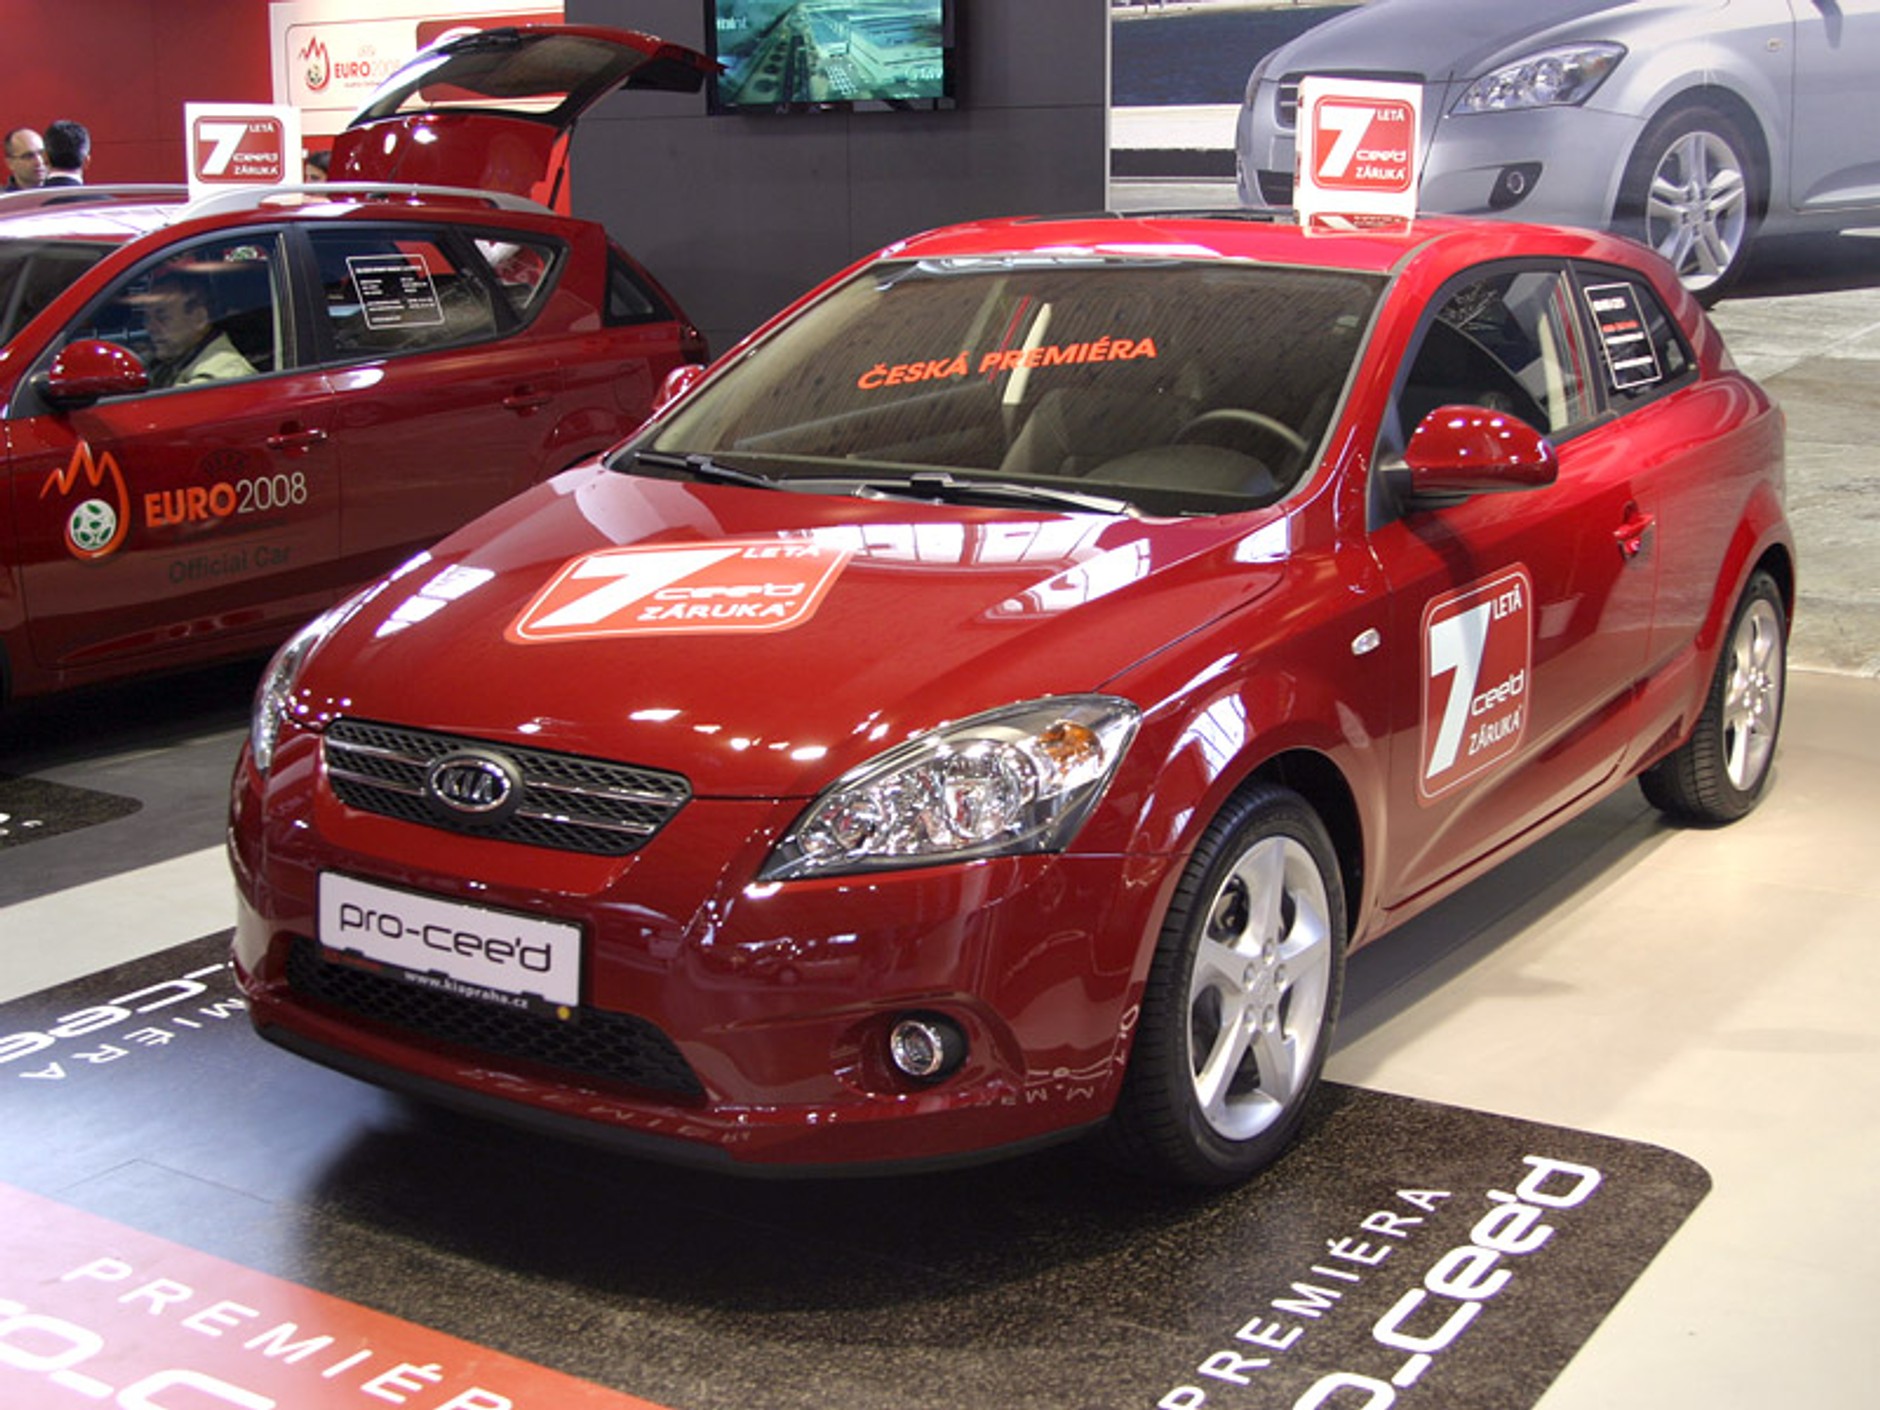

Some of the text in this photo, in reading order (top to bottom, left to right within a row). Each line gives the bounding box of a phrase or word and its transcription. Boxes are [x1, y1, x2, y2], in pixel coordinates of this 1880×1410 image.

[201, 124, 248, 174] 7
[1318, 105, 1405, 178] 7 LETÁ
[857, 335, 1158, 390] ČESKÁ PREMIÉRA
[144, 471, 308, 528] EURO2008
[169, 545, 292, 584] Official Car
[527, 547, 743, 629] 7
[1427, 583, 1523, 779] 7 LETÁ
[443, 767, 494, 802] KIA
[340, 902, 552, 973] pro-cee'd
[403, 969, 529, 1009] www.kiapraha.cz
